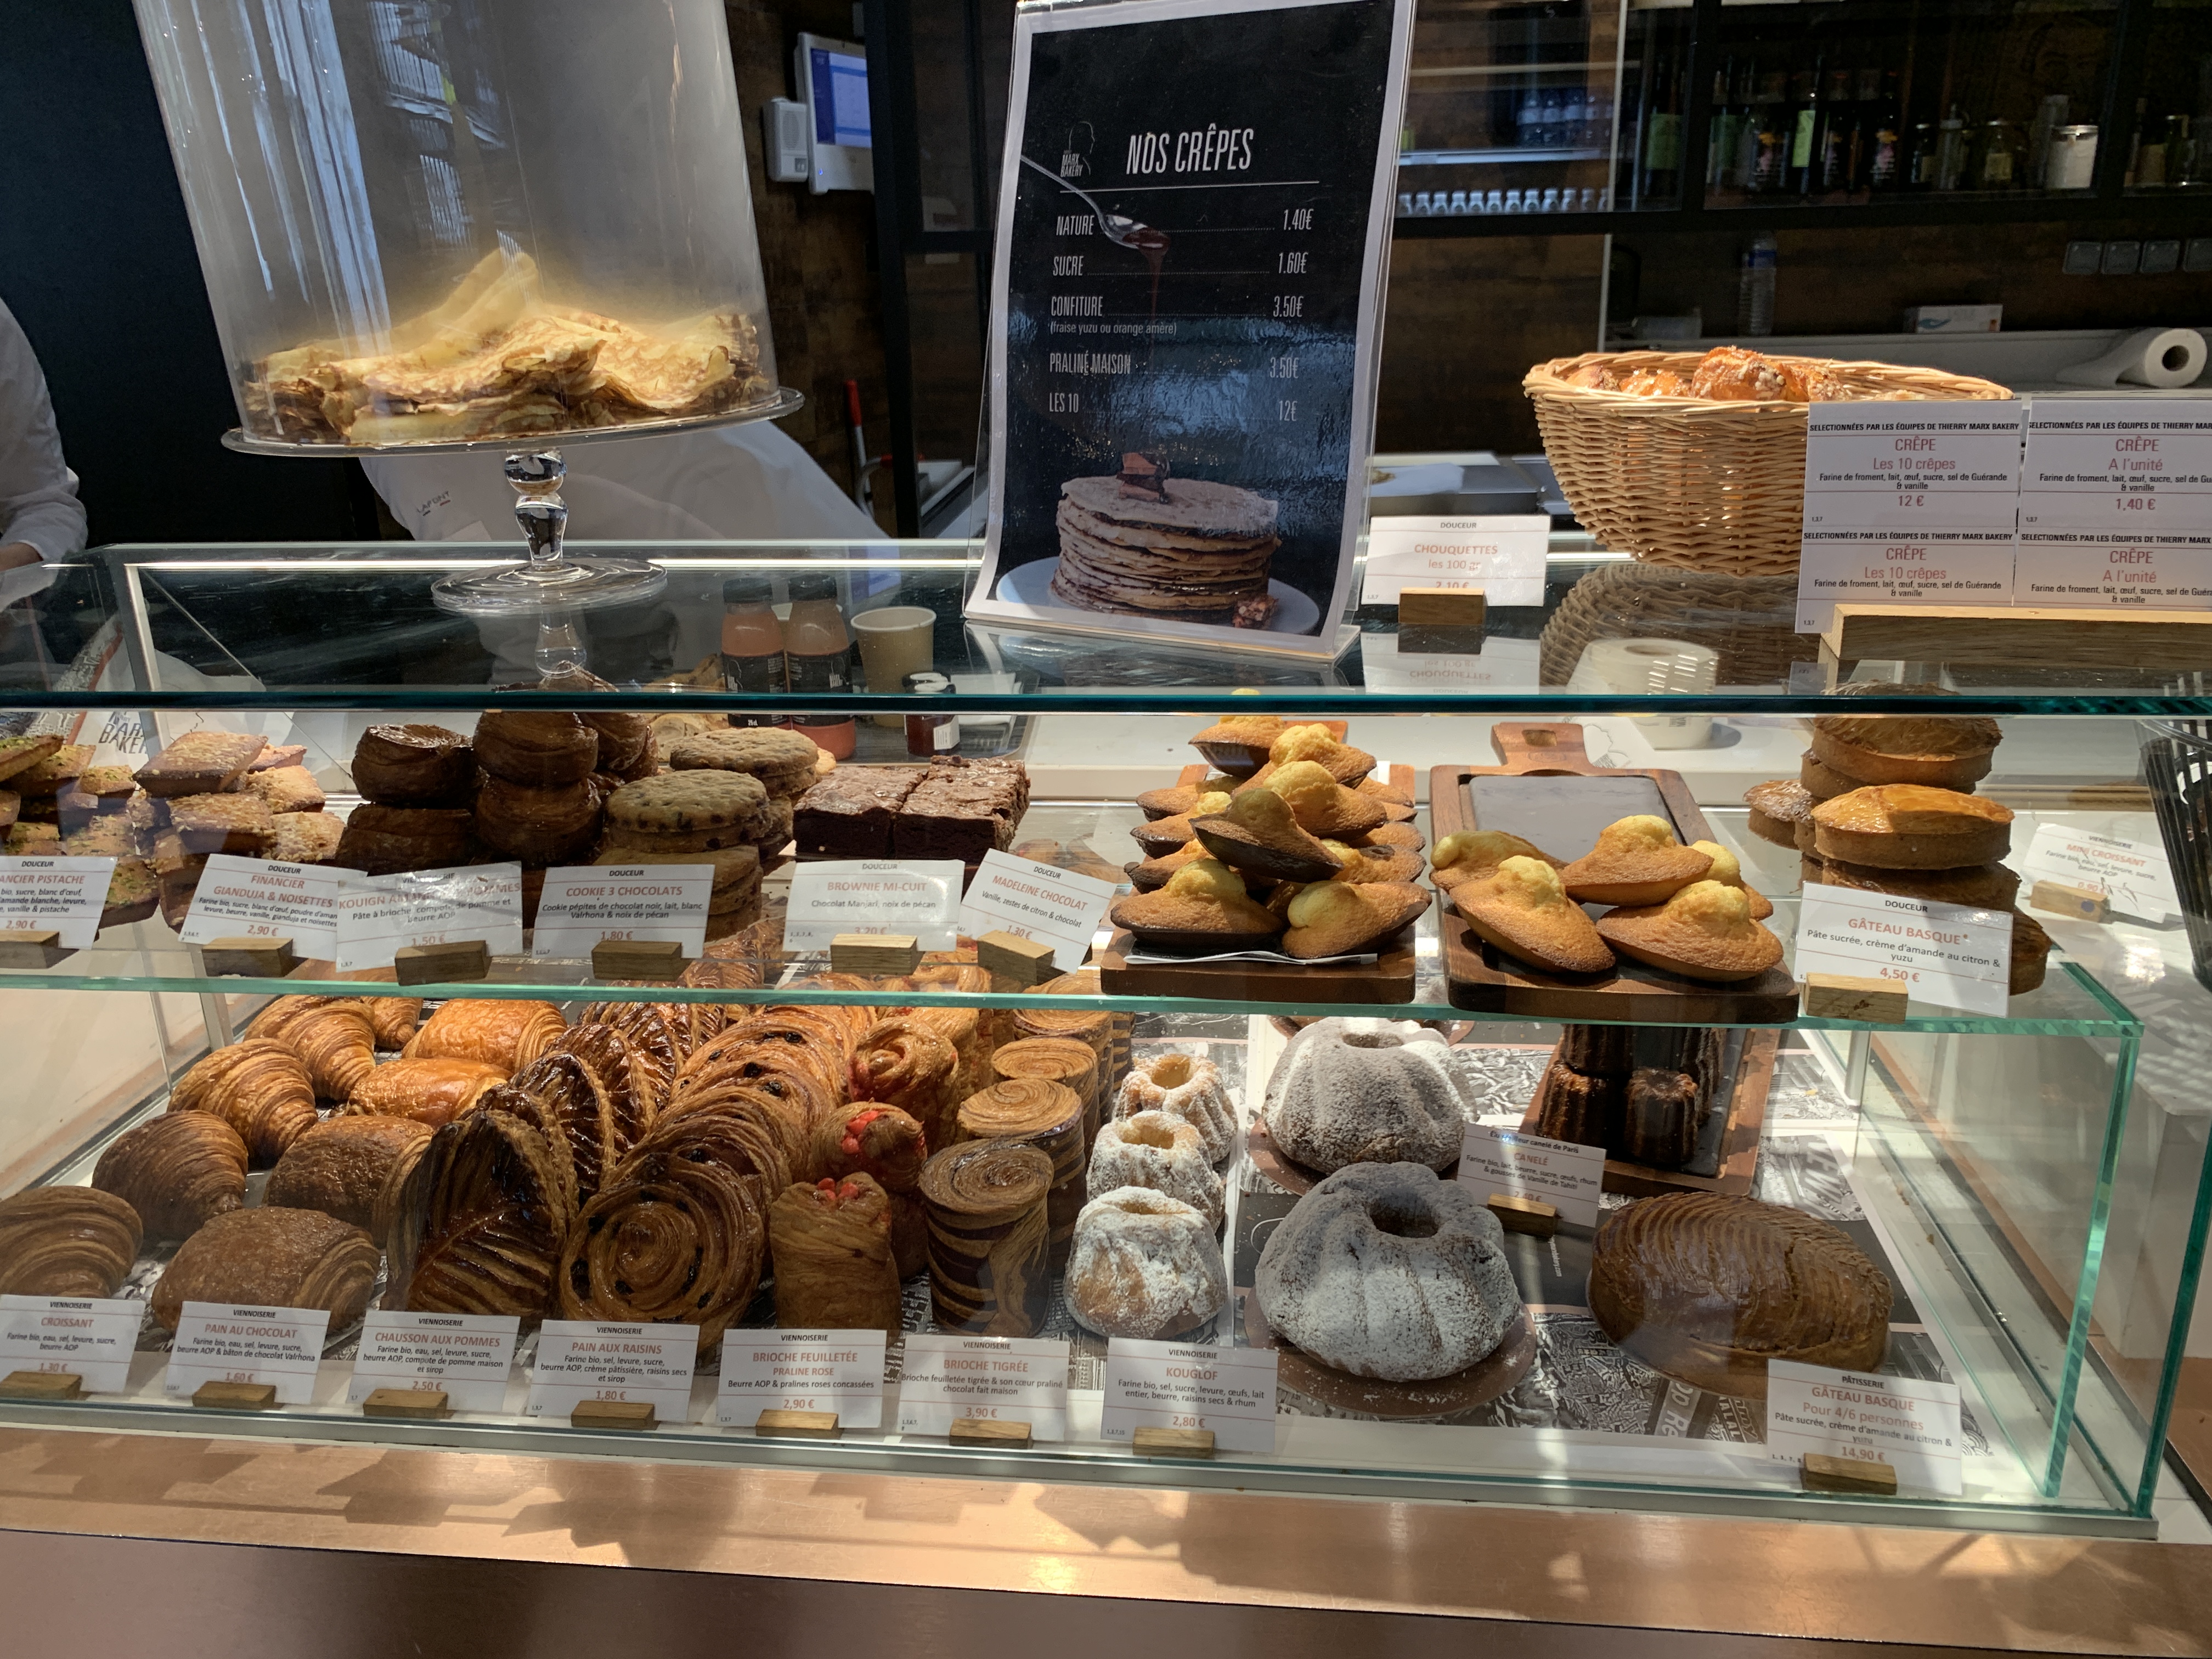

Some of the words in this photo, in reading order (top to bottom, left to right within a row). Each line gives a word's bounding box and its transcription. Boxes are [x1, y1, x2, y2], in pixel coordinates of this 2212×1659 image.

[1126, 133, 1170, 174] NOS
[1175, 123, 1254, 172] CRÊPES
[1062, 154, 1080, 165] MARX
[1060, 165, 1083, 177] BAKERY
[1056, 215, 1095, 236] NATURE
[1283, 209, 1314, 231] 1.40€
[1053, 256, 1083, 276] SUCRE
[1278, 252, 1308, 274] 1.60€
[1051, 296, 1103, 317] CONFITURE
[1273, 296, 1304, 317] 3.50€
[1050, 323, 1076, 335] (fraise
[1079, 324, 1098, 335] yuzu
[1100, 324, 1111, 334] ou
[1113, 324, 1144, 336] orange
[1147, 323, 1177, 336] amère)
[1049, 351, 1089, 373] PRALINÉ
[1093, 354, 1131, 374] MAISON
[1269, 357, 1299, 379] 3.50€
[1049, 393, 1065, 413] LES
[1068, 393, 1079, 413] 10
[1279, 400, 1297, 421] 12€
[1895, 436, 1936, 451] CRÊPE
[2115, 436, 2159, 452] CRÊPE
[1874, 458, 1893, 470] Les
[1900, 458, 1912, 470] 10
[1916, 458, 1955, 472] crêpes
[2108, 458, 2118, 470] A
[1855, 473, 1886, 482] froment,
[1888, 473, 1901, 482] lait,
[1904, 474, 1921, 482] œuf,
[1898, 495, 1912, 507] 12
[1916, 495, 1924, 507] €
[2116, 499, 2143, 511] 1,40
[2148, 499, 2155, 510] €
[1414, 545, 1498, 555] CHOUQUETTES
[1886, 545, 1927, 560] CRÊPE
[2110, 548, 2154, 563] CRÊPE
[1429, 560, 1443, 569] les
[1447, 560, 1466, 569] 100
[1865, 567, 1884, 578] Les
[1891, 567, 1903, 579] 10
[1907, 568, 1946, 582] crêpes
[2103, 570, 2112, 582] A
[2091, 849, 2146, 867] CROISSANT
[268, 865, 301, 874] DOUCEUR
[1034, 866, 1061, 879] DOUCEUR
[37, 876, 85, 884] PISTACHE
[251, 875, 304, 889] FINANCIER
[566, 887, 605, 896] COOKIE
[608, 887, 614, 895] 3
[618, 887, 682, 896] CHOCOLATS
[827, 883, 880, 891] BROWNIE
[883, 883, 927, 891] MI-CUIT
[992, 876, 1040, 896] MADELEINE
[1041, 890, 1088, 911] CHOCOLAT
[214, 886, 264, 900] GIANDUJA
[268, 893, 276, 901] &
[279, 894, 332, 908] NOISETTES
[339, 896, 385, 910] KOUIGN
[982, 891, 1001, 903] Vanille,
[1003, 899, 1020, 909] zestes
[1030, 906, 1047, 917] citron
[1055, 913, 1081, 928] chocolat
[1885, 900, 1928, 912] DOUCEUR
[6, 920, 28, 930] 2,90
[30, 921, 36, 929] €
[247, 925, 269, 936] 2,90
[271, 927, 279, 936] €
[1848, 918, 1902, 935] GÂTEAU
[1906, 928, 1961, 945] BASQUE
[601, 931, 623, 941] 1,80
[626, 932, 633, 940] €
[1007, 925, 1025, 938] 1,30
[1025, 931, 1032, 940] €
[1808, 929, 1827, 939] Pâte
[1830, 932, 1863, 946] sucrée,
[1866, 938, 1895, 950] crème
[1962, 953, 1990, 966] citron
[1993, 959, 2000, 967] &
[1891, 953, 1913, 963] yuzu
[1880, 968, 1908, 981] 4,50
[1912, 973, 1920, 983] €
[1514, 1153, 1548, 1166] CANELÉ
[233, 1310, 275, 1318] VIENNOISERIE
[41, 1317, 94, 1328] CROISSANT
[205, 1324, 227, 1333] PAIN
[229, 1325, 244, 1335] AU
[246, 1327, 297, 1338] CHOCOLAT
[375, 1332, 428, 1343] CHAUSSON
[431, 1335, 452, 1344] AUX
[455, 1336, 500, 1347] POMMES
[963, 1341, 1011, 1350] VIENNOISERIE
[572, 1342, 596, 1352] PAIN
[598, 1344, 620, 1352] AUX
[623, 1344, 662, 1355] RAISINS
[1169, 1349, 1217, 1359] VIENNOISERIE
[753, 1353, 797, 1362] BRIOCHE
[800, 1351, 857, 1362] FEUILLETÉE
[944, 1359, 989, 1370] BRIOCHE
[992, 1361, 1028, 1372] TIGRÉE
[1166, 1367, 1218, 1380] KOUGLOF
[413, 1381, 433, 1391] 2,50
[436, 1383, 442, 1391] €
[1842, 1375, 1884, 1389] PÂTISSERIE
[596, 1391, 617, 1401] 1,80
[620, 1391, 626, 1400] €
[1812, 1386, 1861, 1403] GÂTEAU
[1865, 1395, 1915, 1411] BASQUE
[783, 1400, 805, 1410] 2,90
[808, 1400, 815, 1408] €
[966, 1408, 988, 1419] 3,90
[991, 1408, 997, 1418] €
[1803, 1402, 1831, 1417] Pour
[1835, 1407, 1856, 1420] 4/6
[1860, 1412, 1923, 1430] personnes
[1173, 1417, 1195, 1427] 2,80
[1199, 1418, 1205, 1427] €
[1841, 1446, 1874, 1460] 14,90
[1877, 1452, 1884, 1462] €
